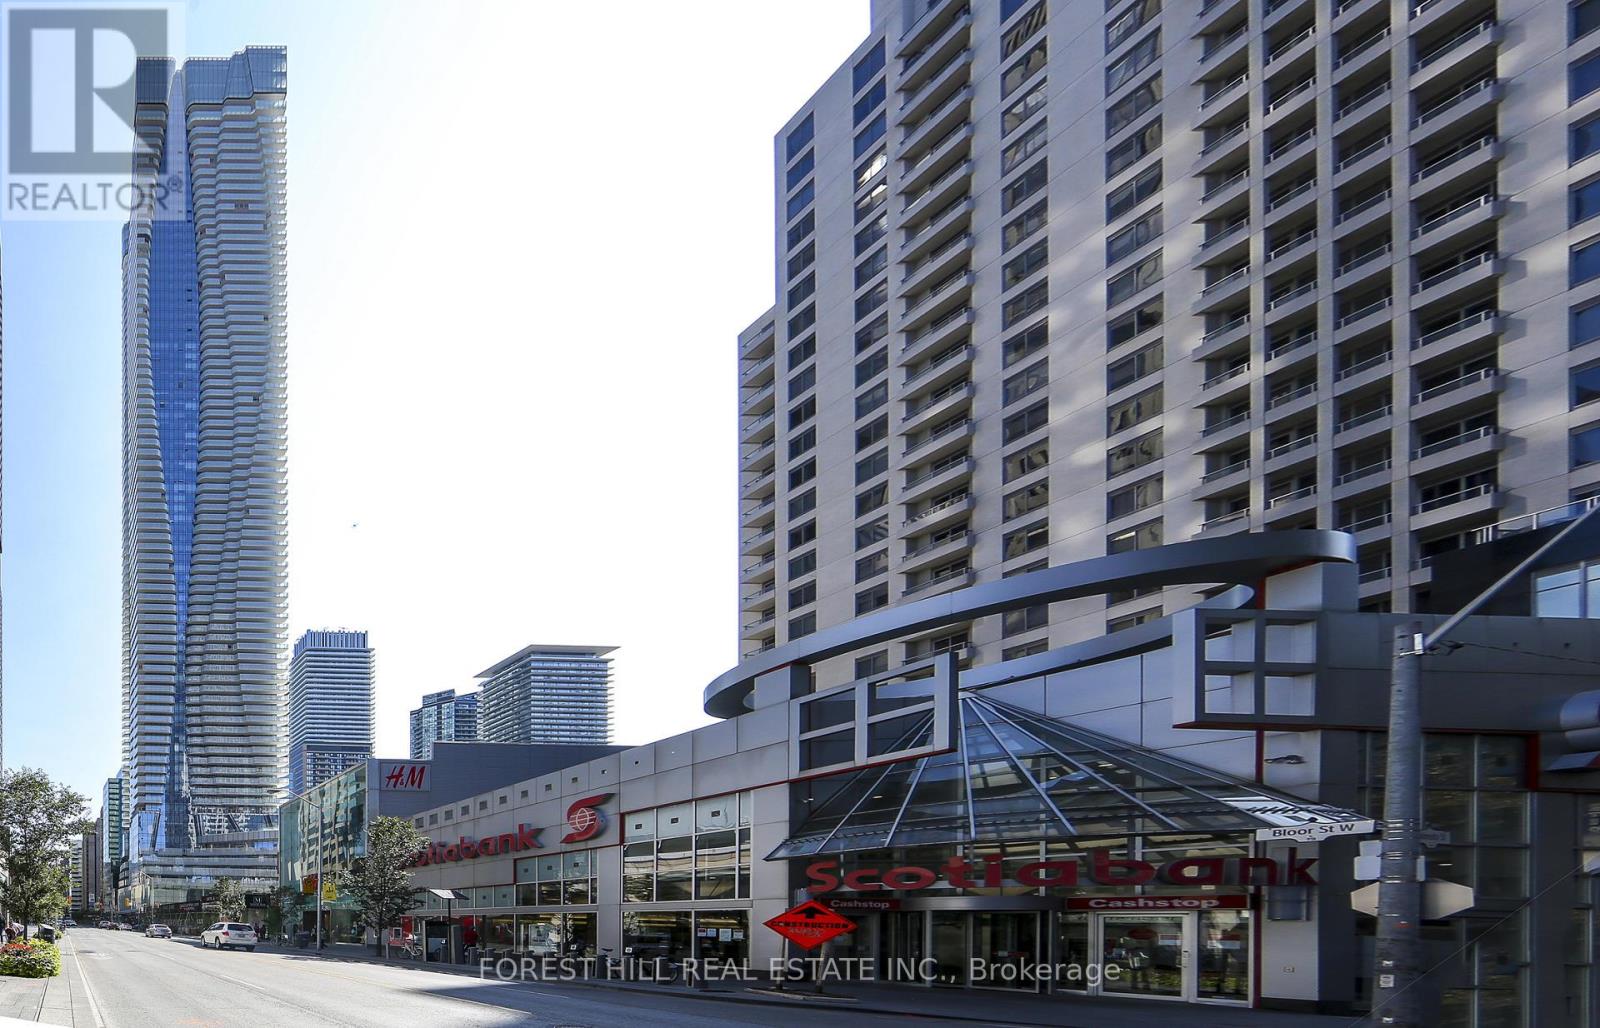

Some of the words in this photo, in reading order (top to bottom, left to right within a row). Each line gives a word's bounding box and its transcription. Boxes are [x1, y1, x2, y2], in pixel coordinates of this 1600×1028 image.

[385, 765, 426, 789] H&M
[1272, 828, 1313, 837] Bloor
[1319, 825, 1335, 834] St
[1340, 823, 1355, 832] W
[805, 847, 1320, 893] Scotiabank
[830, 899, 890, 910] Cashstop
[1088, 898, 1220, 909] Cashstop
